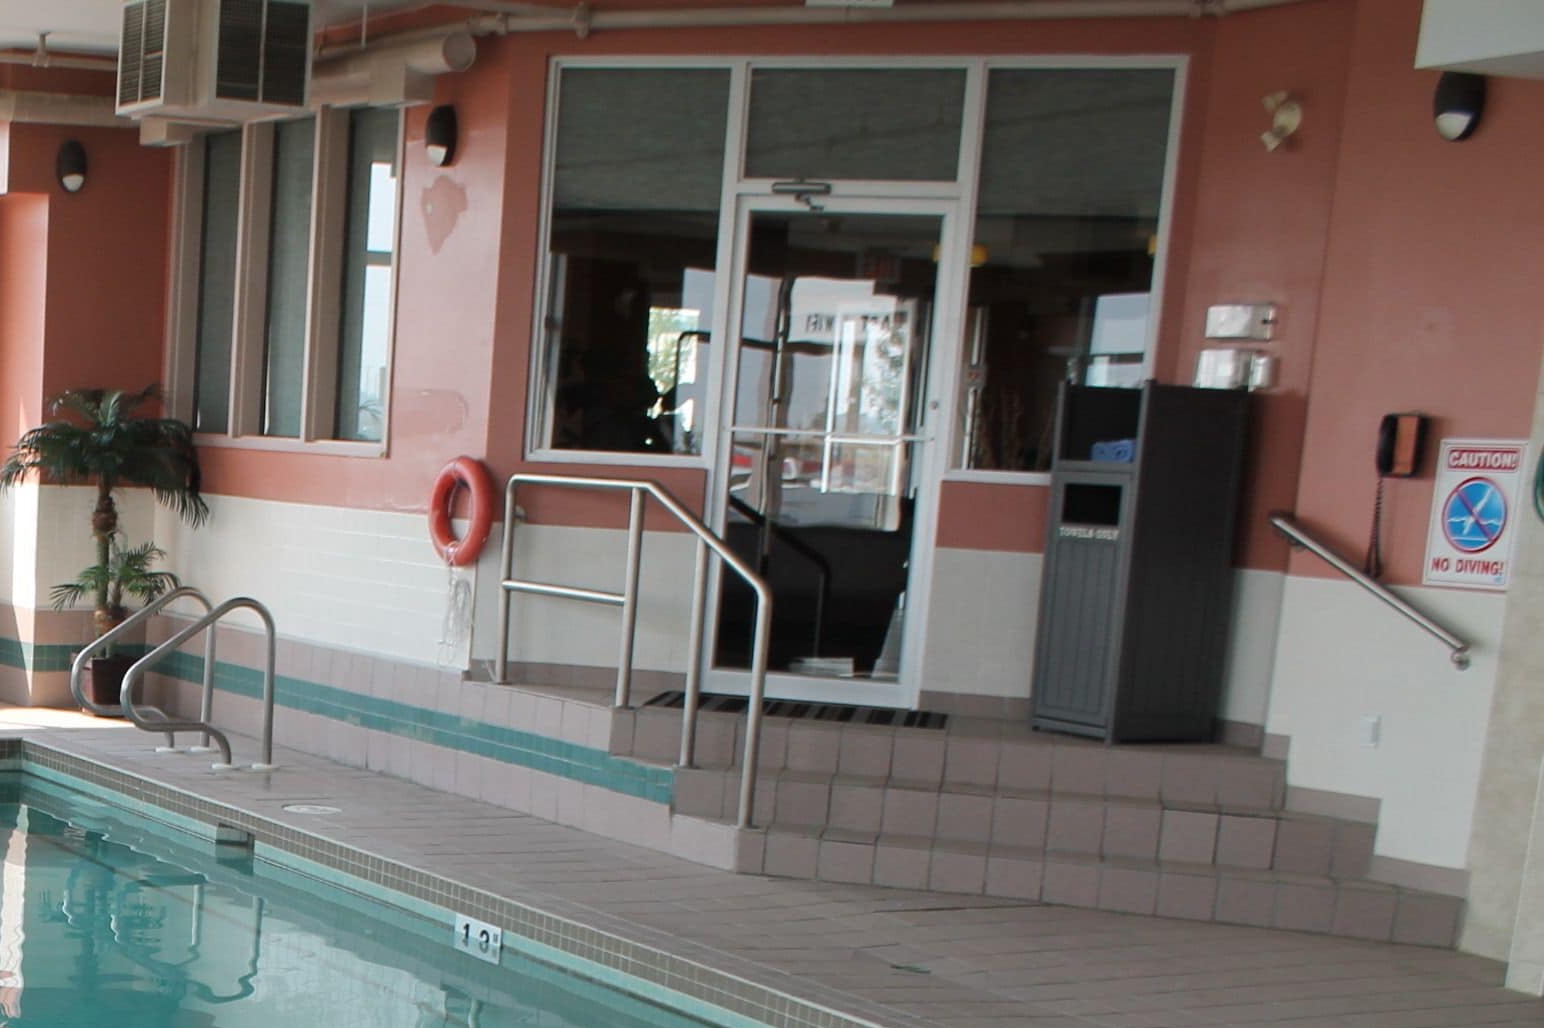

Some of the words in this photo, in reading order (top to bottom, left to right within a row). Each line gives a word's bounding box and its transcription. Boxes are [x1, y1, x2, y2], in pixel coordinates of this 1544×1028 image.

[1448, 451, 1518, 470] CAUTION!
[1431, 557, 1450, 572] NO
[1455, 559, 1504, 576] DIVING!
